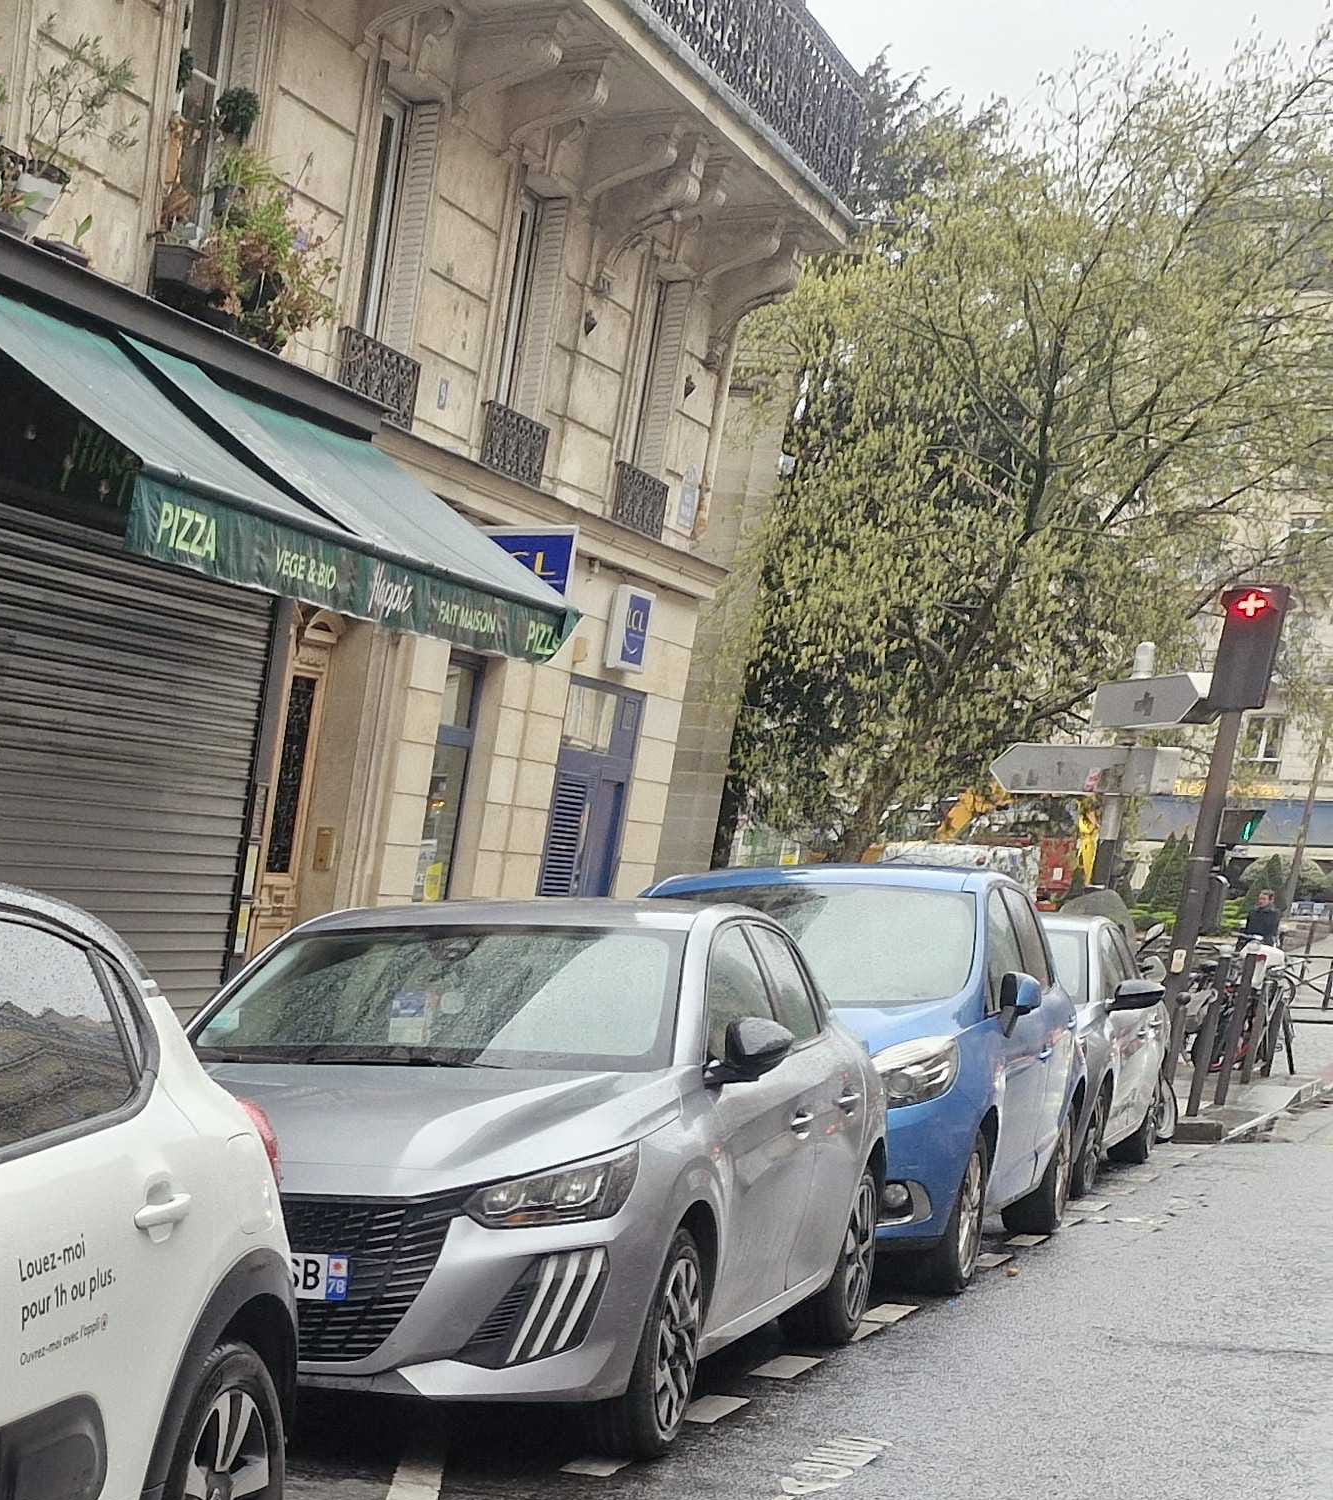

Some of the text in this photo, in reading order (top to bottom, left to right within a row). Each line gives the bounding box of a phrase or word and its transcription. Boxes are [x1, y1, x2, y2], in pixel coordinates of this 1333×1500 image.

[157, 501, 216, 561] PIZZA
[276, 546, 306, 580] VEGE
[318, 561, 337, 592] BIO
[437, 600, 497, 635] FAIT MAISON
[627, 608, 645, 633] LCL
[18, 1232, 86, 1282] Louez-moi
[21, 1266, 116, 1332] pour 1h ou plus.
[327, 1279, 346, 1294] 78
[19, 1340, 61, 1366] Ouvrez-moi
